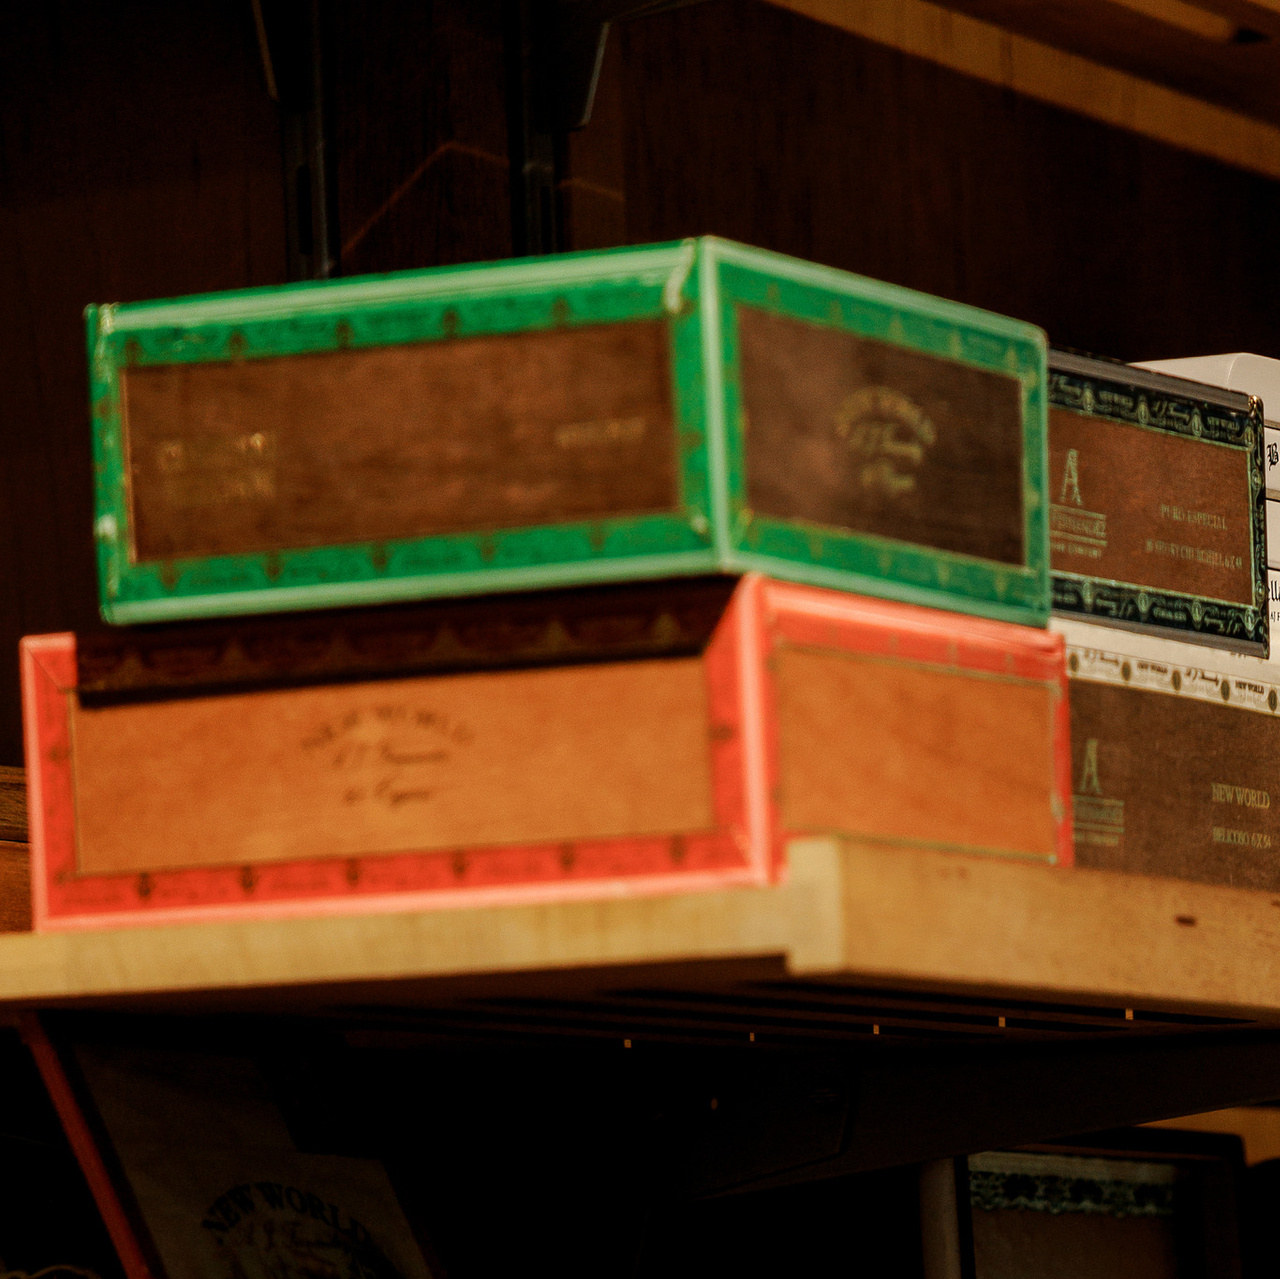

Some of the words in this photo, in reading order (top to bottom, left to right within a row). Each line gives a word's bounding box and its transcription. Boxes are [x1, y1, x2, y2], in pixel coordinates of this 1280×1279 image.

[1186, 509, 1229, 531] ESPECIAL
[1270, 611, 1276, 623] AJ
[1211, 782, 1234, 804] NEW
[1236, 786, 1271, 810] WORLD
[202, 1183, 255, 1232] NEW
[255, 1181, 374, 1248] WORLD
